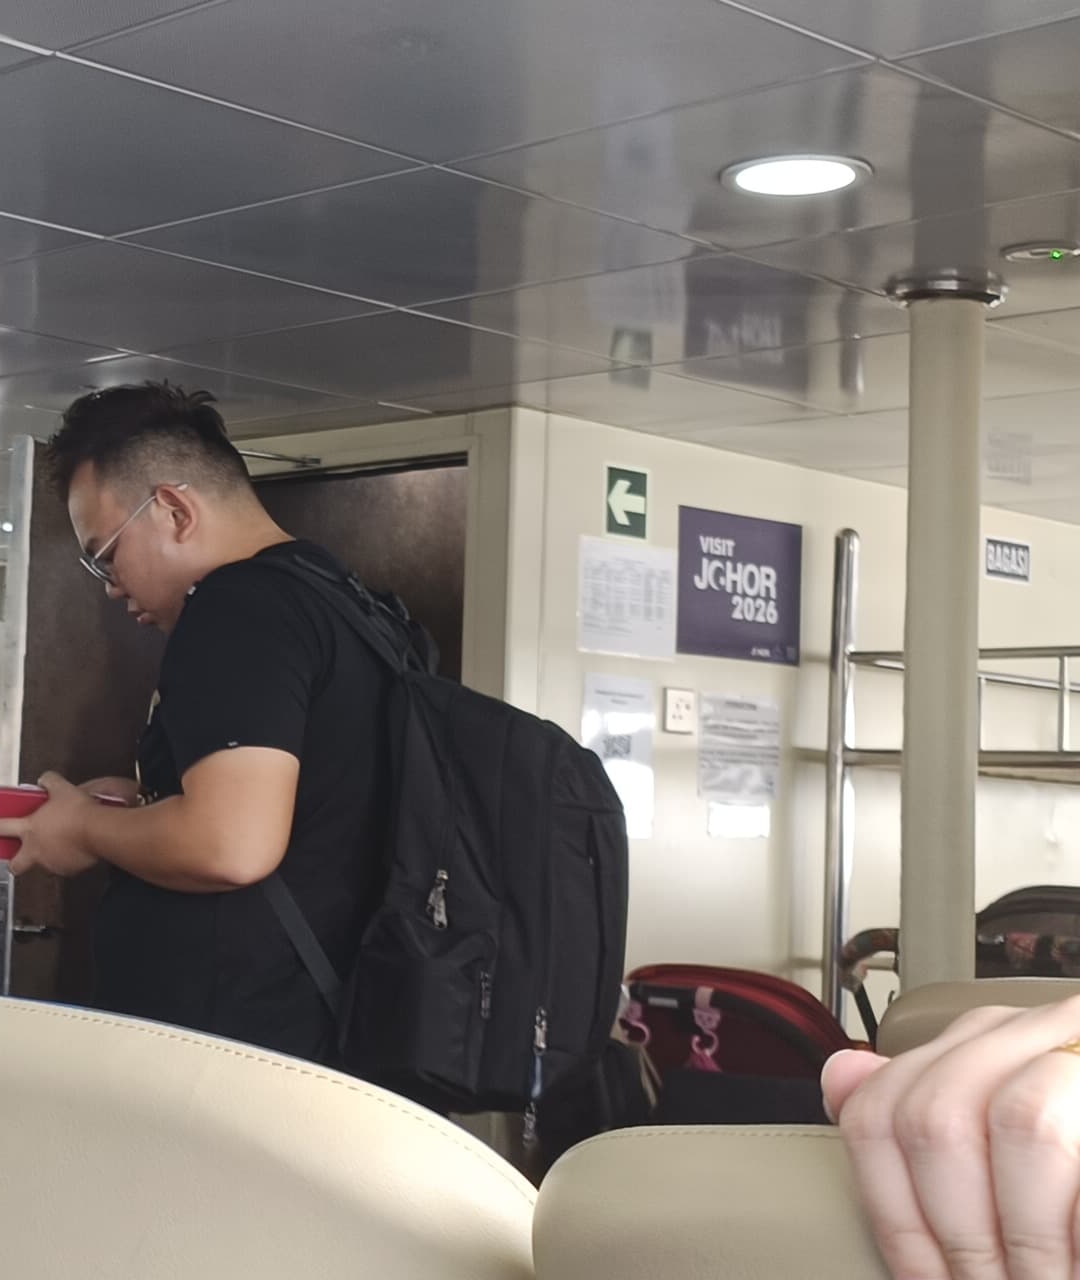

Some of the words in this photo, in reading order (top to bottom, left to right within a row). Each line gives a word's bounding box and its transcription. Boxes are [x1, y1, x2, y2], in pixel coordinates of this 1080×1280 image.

[699, 535, 736, 557] VISIT
[987, 543, 1029, 577] BAGASI
[731, 595, 779, 624] 2026
